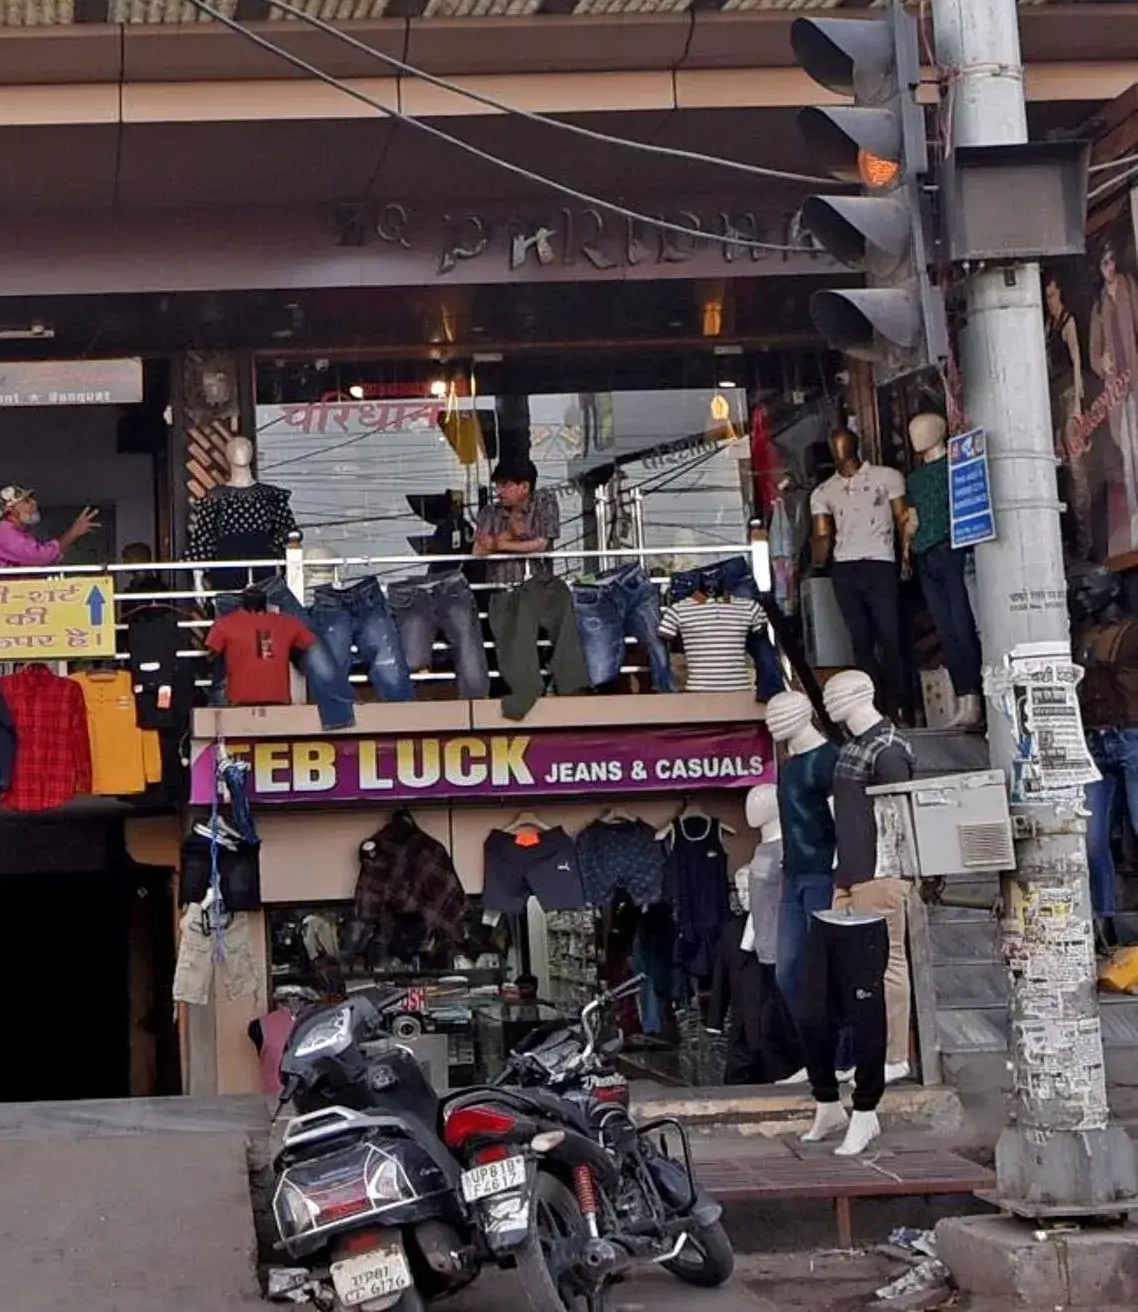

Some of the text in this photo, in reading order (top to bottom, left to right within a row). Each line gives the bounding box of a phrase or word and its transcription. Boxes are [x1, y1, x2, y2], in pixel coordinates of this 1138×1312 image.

[5, 606, 49, 627] की
[359, 736, 534, 790] LUCK
[545, 761, 623, 784] JEANS
[631, 760, 648, 781] &
[655, 755, 764, 780] CASUALS
